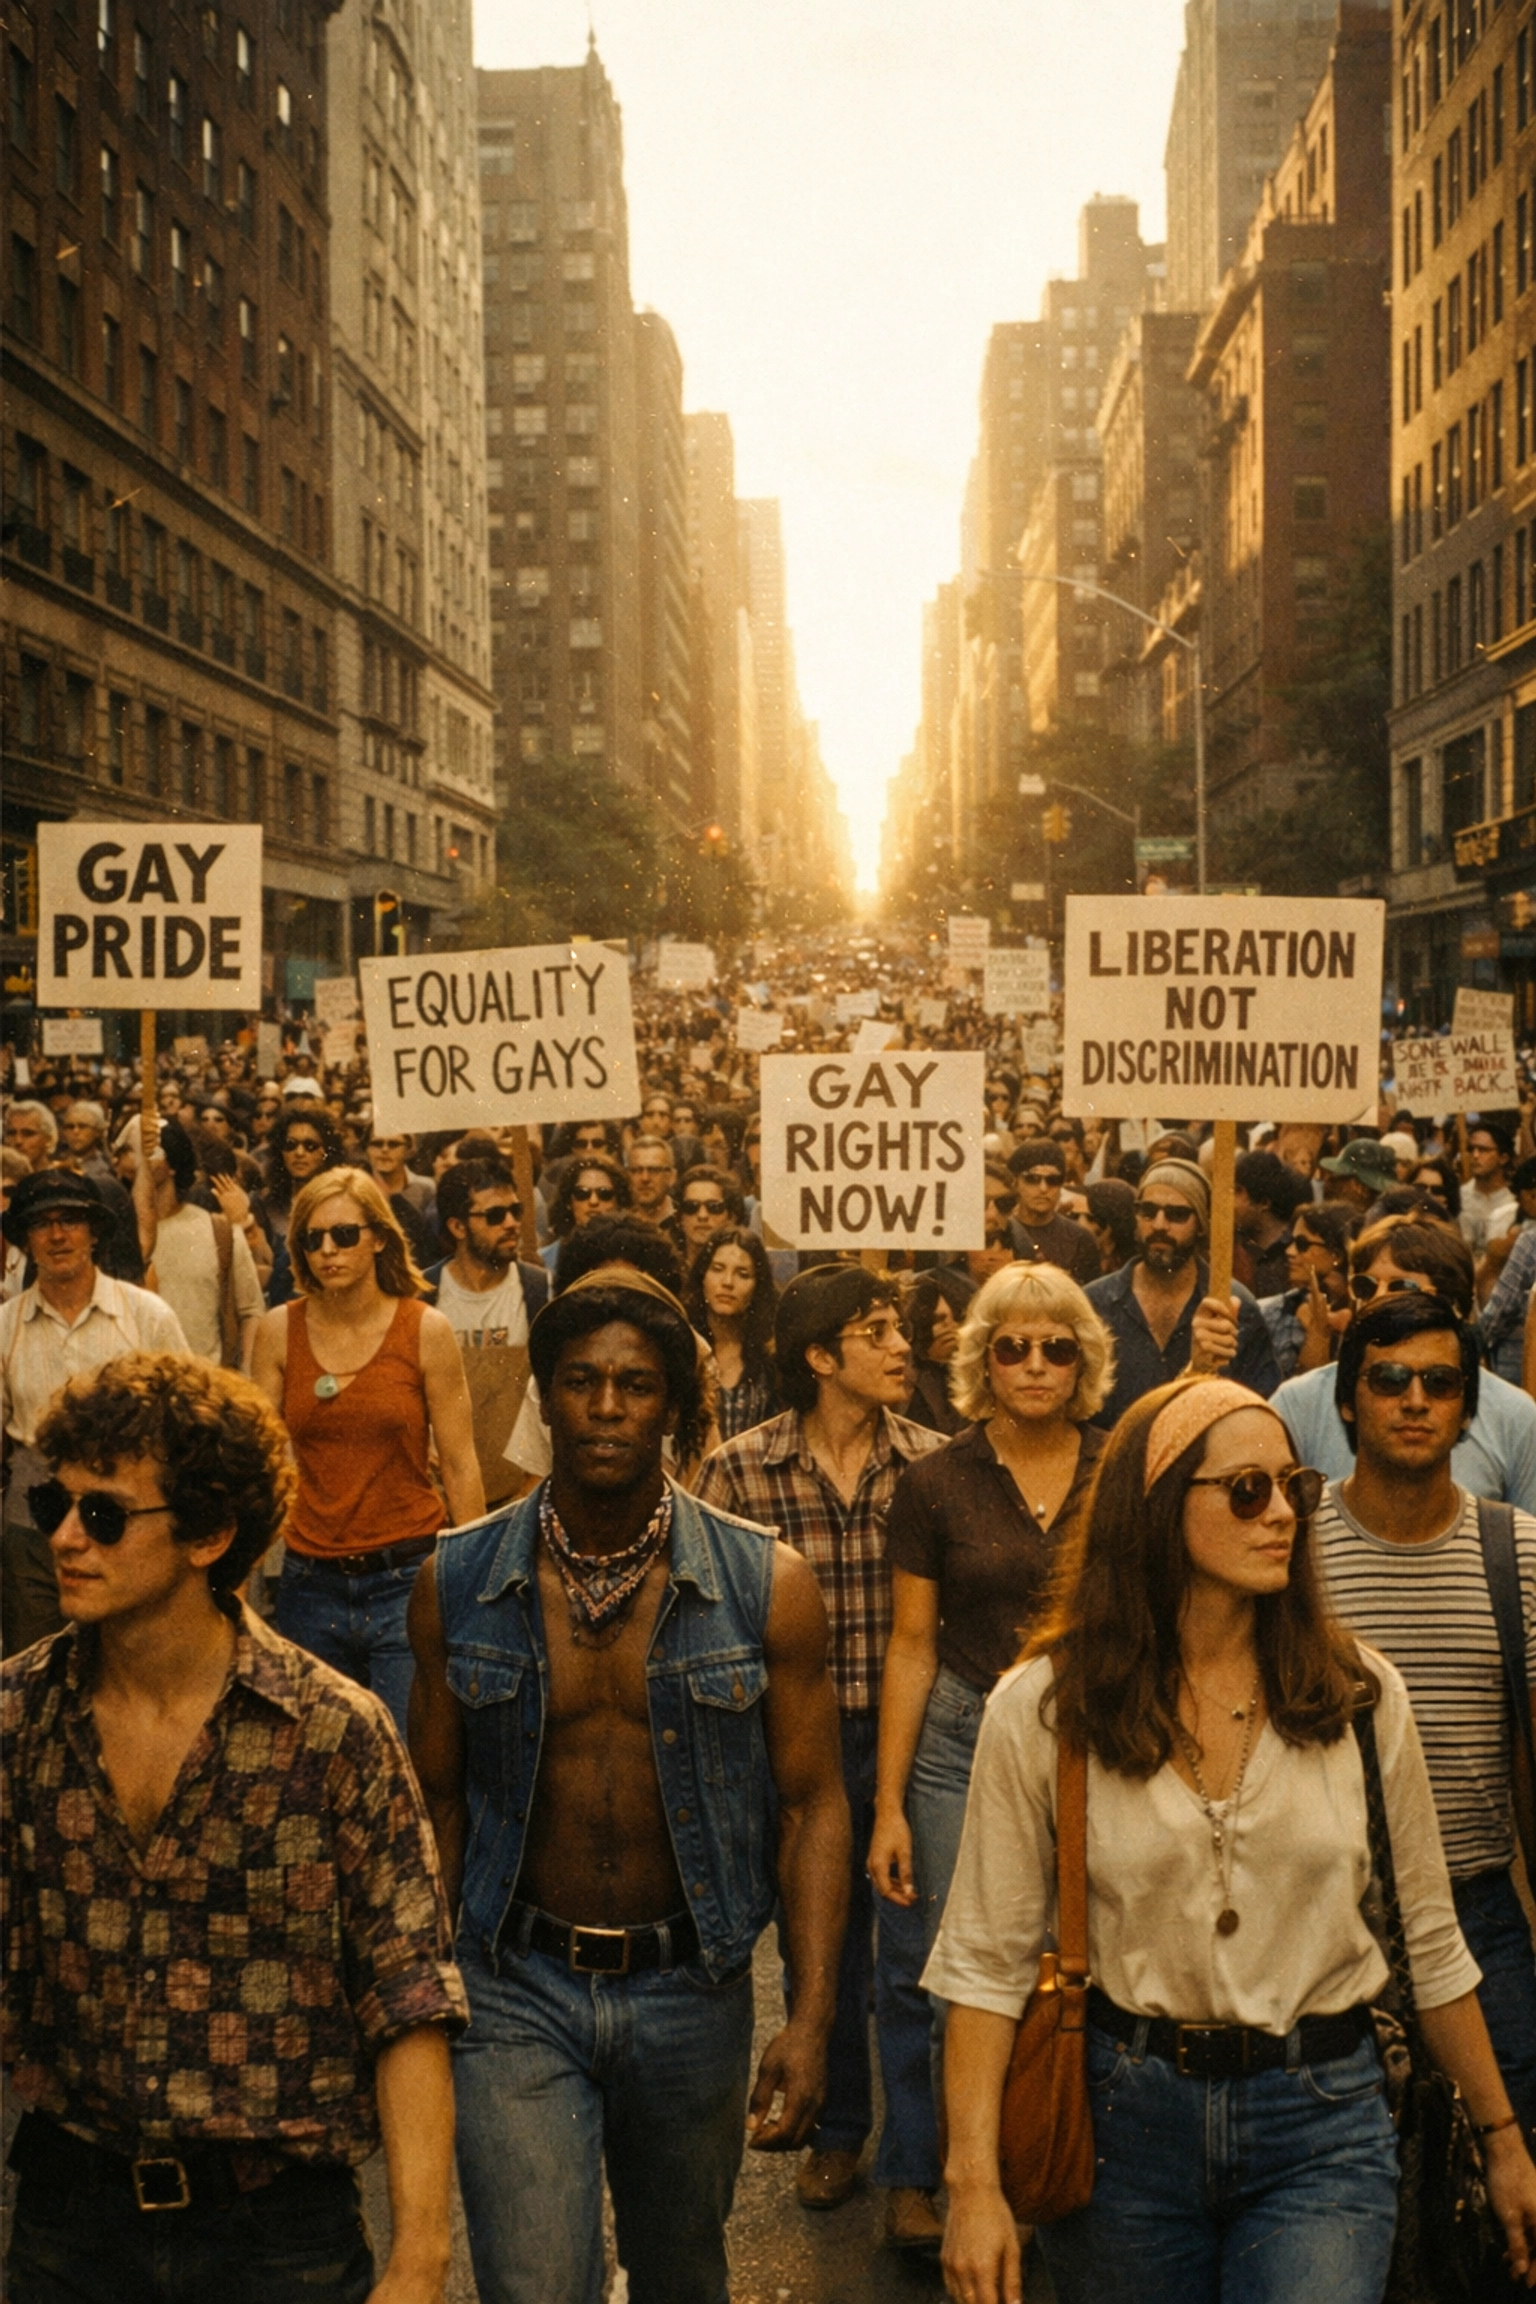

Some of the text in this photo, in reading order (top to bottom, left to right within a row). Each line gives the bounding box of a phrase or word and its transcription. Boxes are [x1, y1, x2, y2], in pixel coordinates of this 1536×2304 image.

[77, 842, 224, 904] GAY
[53, 914, 240, 979] PRIDE
[1090, 929, 1355, 978] LIBERATION
[388, 963, 604, 1029] EQUALITY
[1166, 986, 1256, 1030] NOT
[394, 1036, 607, 1098] FOR GAYS
[809, 1062, 938, 1109] GAY
[1083, 1040, 1358, 1089] DISCRIMINATION
[787, 1121, 965, 1172] RIGHTS
[800, 1182, 946, 1236] NOW!
